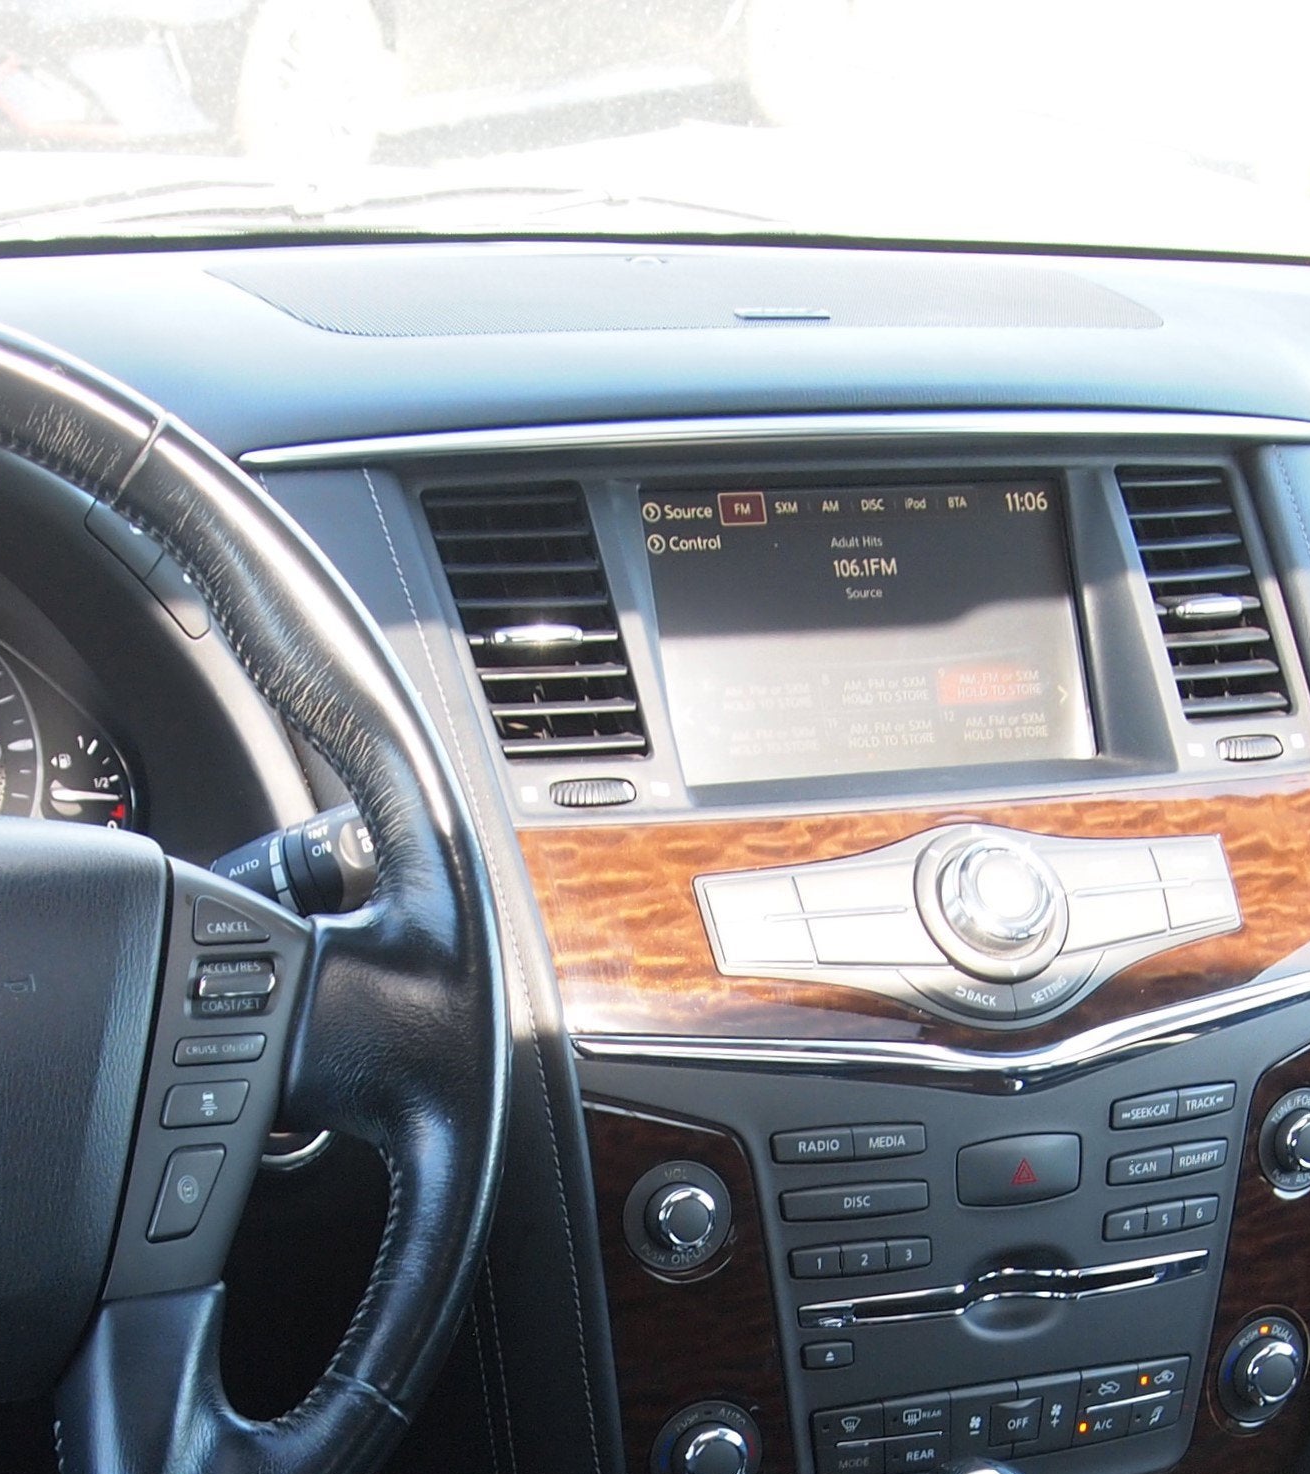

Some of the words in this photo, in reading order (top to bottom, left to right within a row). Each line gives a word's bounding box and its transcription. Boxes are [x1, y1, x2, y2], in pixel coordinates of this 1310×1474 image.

[775, 502, 798, 513] SXM
[822, 500, 839, 512] AM
[861, 499, 885, 511] DISC
[904, 497, 926, 509] iPod
[1005, 491, 1048, 512] 11:06
[664, 504, 713, 519] Source
[734, 503, 751, 515] FM
[669, 535, 722, 551] Control
[831, 536, 859, 548] Adult
[862, 536, 883, 547] Hits
[846, 587, 883, 599] Source
[311, 840, 332, 857] ON
[229, 858, 260, 878] AUTO
[207, 922, 251, 934] CANCEL
[202, 962, 261, 974] ACCEL/RES
[1030, 975, 1068, 1004] SETTING
[967, 989, 996, 1007] BACK
[201, 1000, 261, 1012] COAST/SET
[1186, 1095, 1216, 1111] TRACK
[798, 1139, 840, 1153] RADIO
[868, 1135, 906, 1149] MEDIA
[1129, 1161, 1157, 1176] SCAN
[843, 1195, 871, 1209] DISC
[1196, 1207, 1203, 1219] 6
[1123, 1219, 1130, 1231] 4
[1162, 1214, 1168, 1226] 5
[861, 1253, 869, 1266] 2
[905, 1248, 913, 1261] 3
[817, 1257, 822, 1270] 1
[1007, 1416, 1029, 1430] OFF
[1094, 1418, 1113, 1432] A/C
[906, 1448, 935, 1462] REAR
[840, 1458, 870, 1469] MODE
